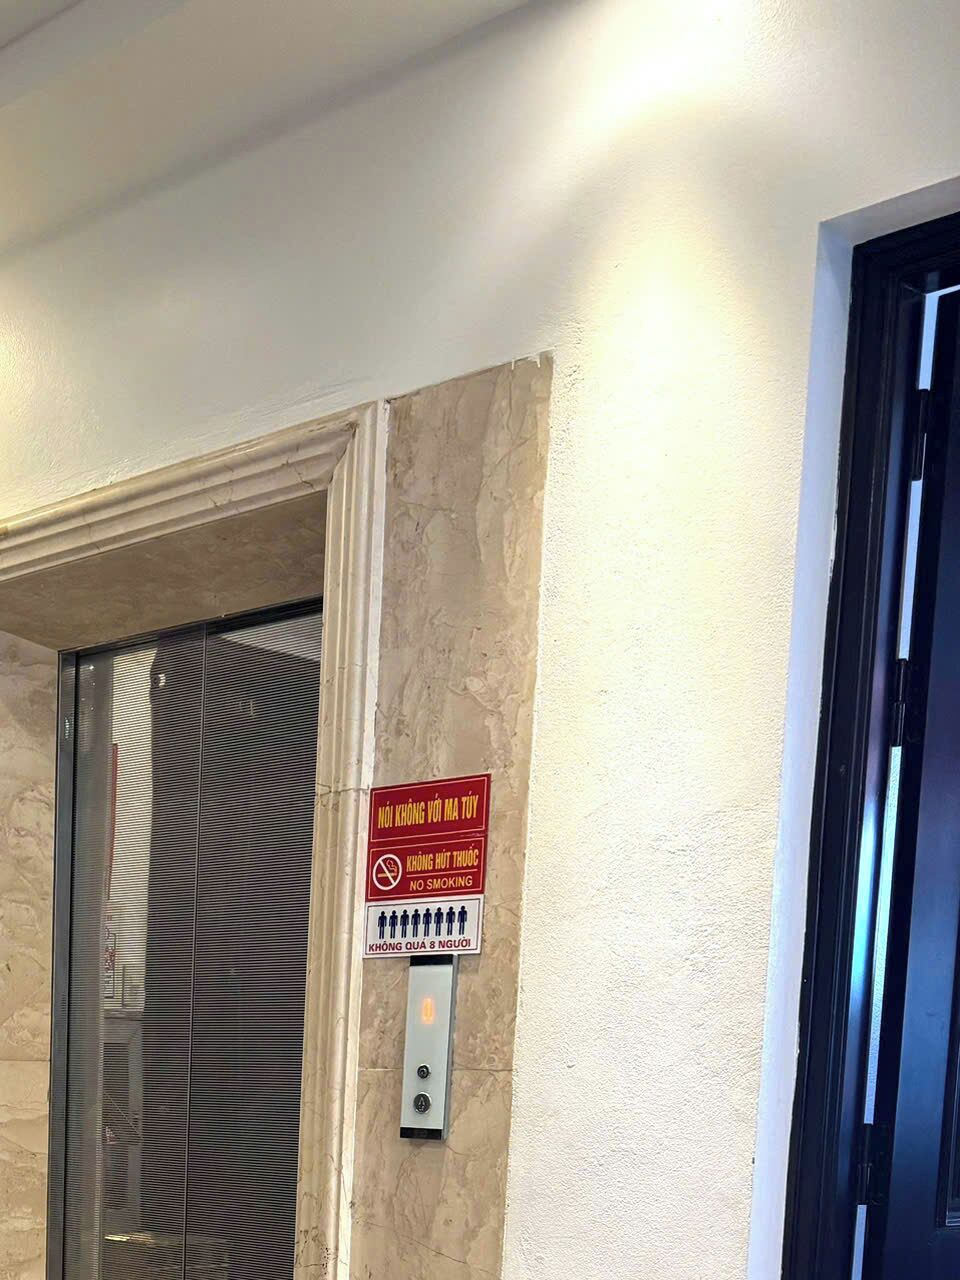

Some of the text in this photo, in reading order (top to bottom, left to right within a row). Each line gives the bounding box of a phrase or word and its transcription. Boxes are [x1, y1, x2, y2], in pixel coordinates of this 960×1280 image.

[377, 790, 479, 829] NÓI KHÔNG VỚI MA TÚY
[406, 843, 479, 872] KHÔNG HÚT THUỐC
[409, 875, 473, 891] NO SMOKING
[368, 936, 471, 952] KHÔNG QUÁ 8 NGƯỜI
